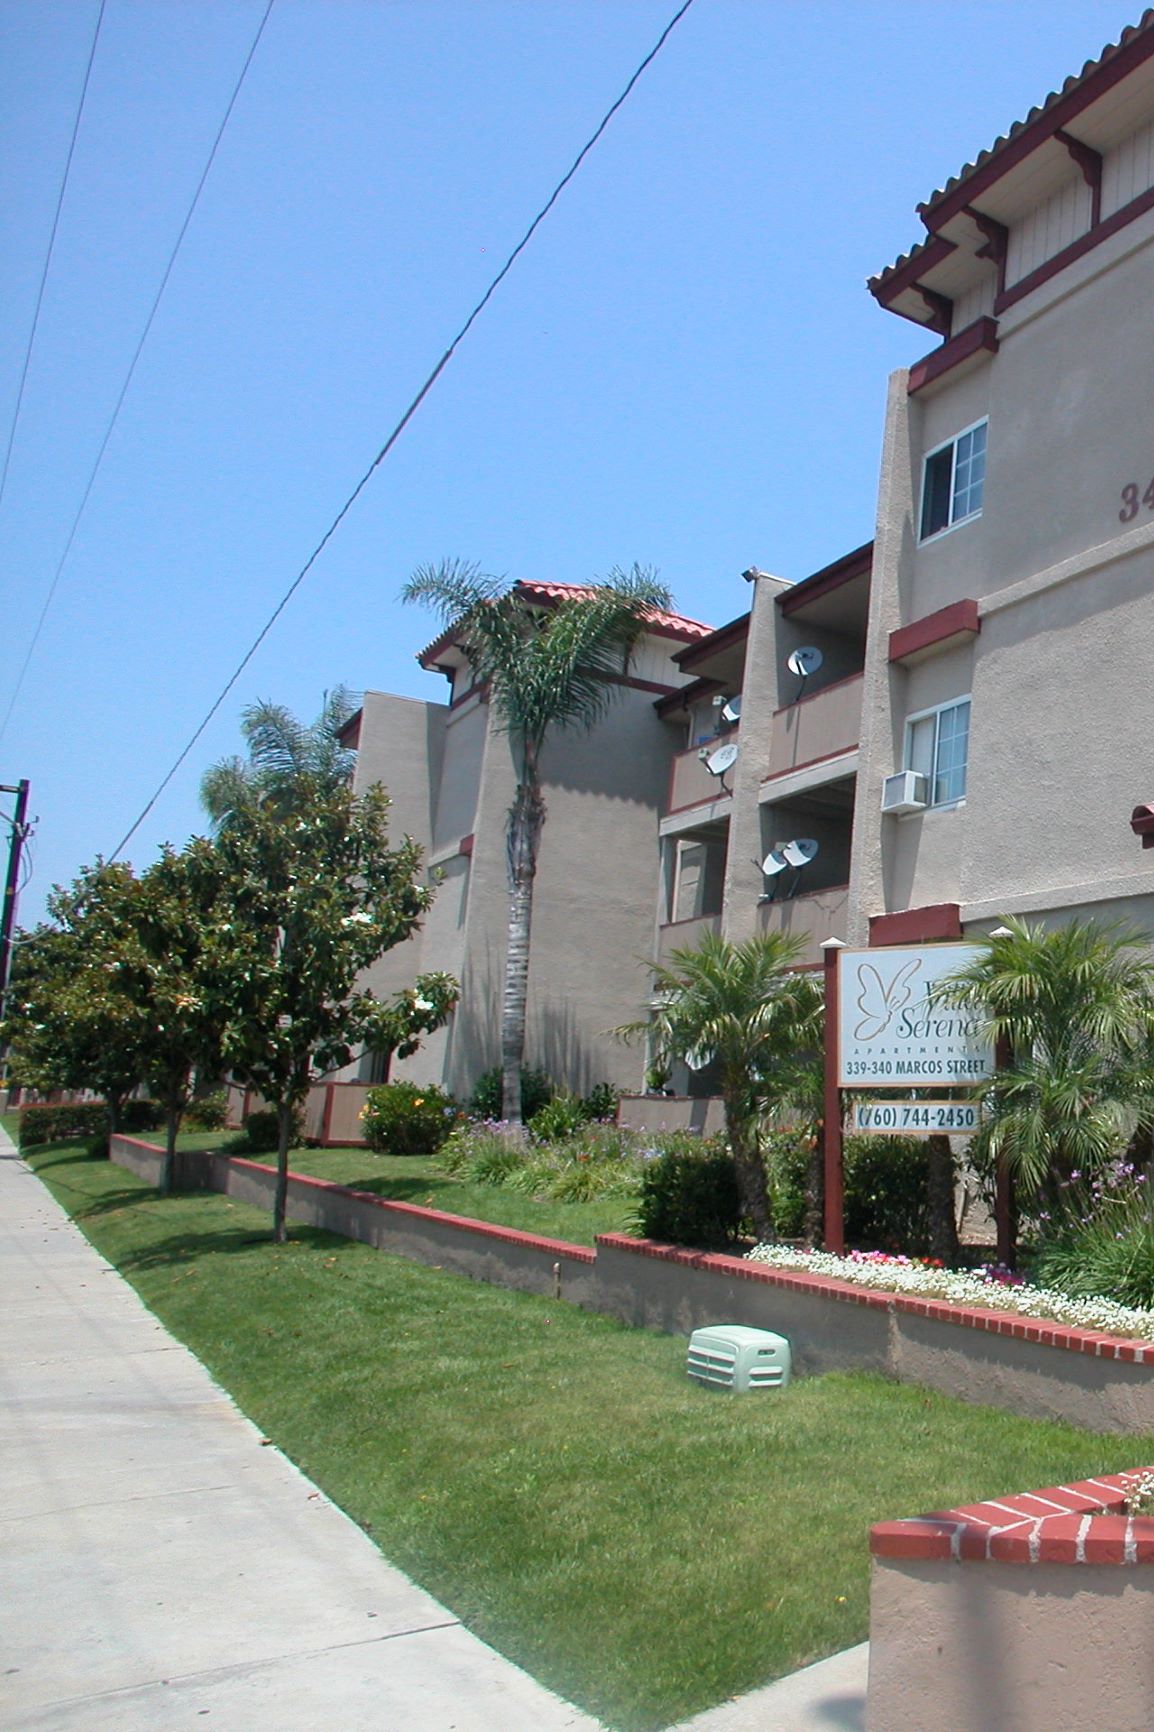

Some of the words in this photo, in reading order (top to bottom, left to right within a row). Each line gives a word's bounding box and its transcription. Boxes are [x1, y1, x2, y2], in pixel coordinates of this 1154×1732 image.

[854, 1045, 980, 1055] APARTMENTS
[846, 1061, 892, 1075] 339-340
[895, 1060, 943, 1074] MARCOS
[947, 1059, 985, 1074] STREET
[902, 1107, 975, 1126] 744-2450
